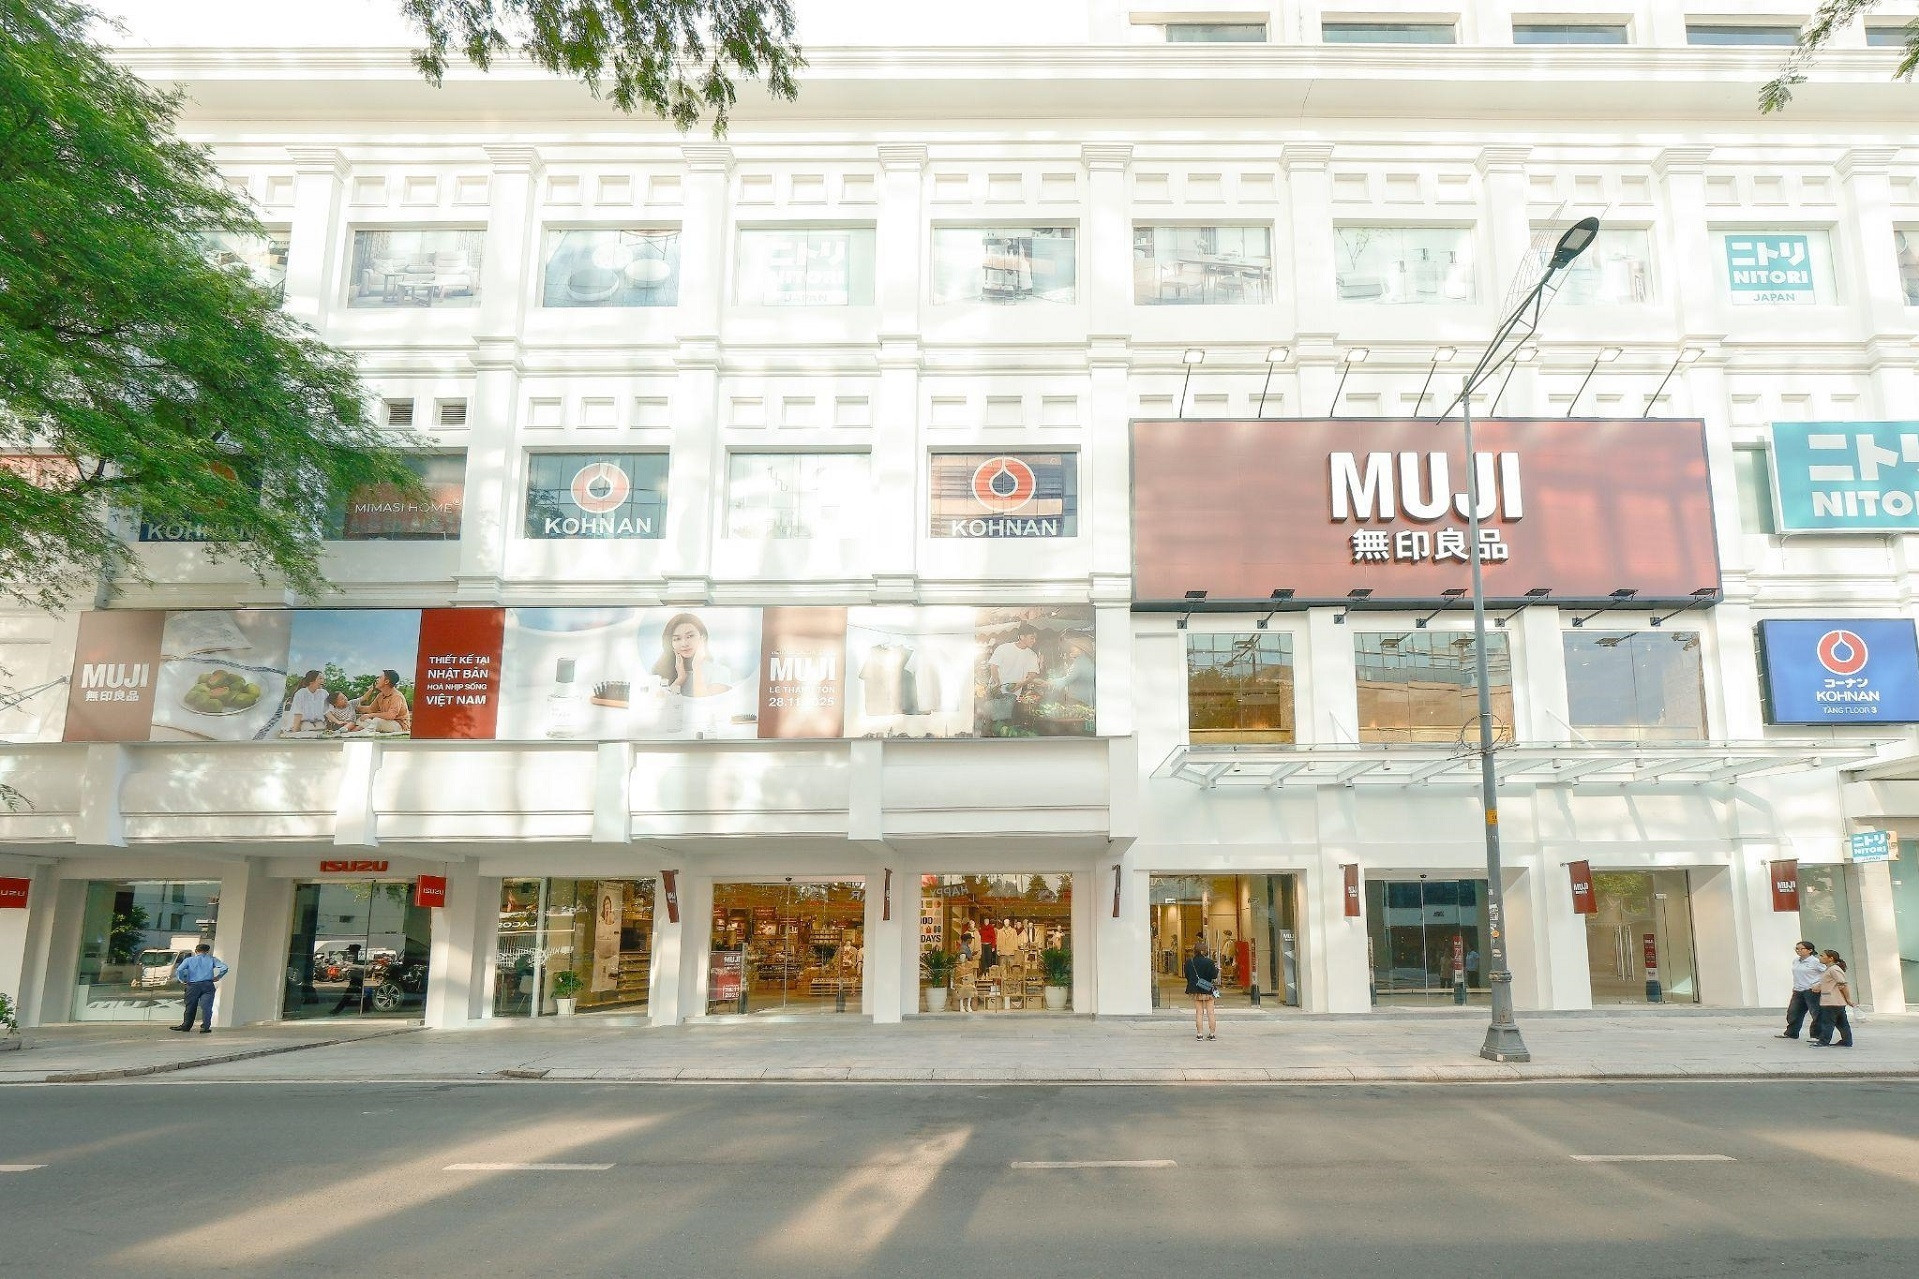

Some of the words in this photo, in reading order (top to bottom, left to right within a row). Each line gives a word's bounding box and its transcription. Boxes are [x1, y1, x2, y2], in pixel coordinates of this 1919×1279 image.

[1731, 242, 1805, 266] ニトリ
[1733, 270, 1809, 284] NITORI
[1753, 293, 1796, 302] JAPAN
[1329, 452, 1523, 524] MUJI
[354, 502, 404, 513] MIMASI
[408, 502, 452, 513] HOME
[1811, 490, 1919, 517] NITO
[544, 517, 652, 535] KOHNAN
[951, 519, 1057, 537] KOHNAN
[1350, 528, 1509, 564] 無印良品
[429, 654, 458, 664] THIẾT
[459, 654, 474, 664] KẾ
[475, 656, 490, 666] TẠI
[81, 663, 150, 688] MUJI
[428, 667, 461, 681] NHẬT
[770, 657, 836, 682] MUJI
[1824, 678, 1869, 688] コーナン
[85, 690, 139, 702] 無印良品
[426, 693, 454, 707] VIỆT
[456, 694, 487, 705] NAM
[1816, 691, 1880, 702] KOHNAN
[1845, 706, 1870, 714] FLOOR
[1871, 706, 1878, 714] 3
[1853, 833, 1885, 847] ニトリ
[1854, 846, 1887, 855] NITORI
[320, 860, 389, 873] ISUZU
[423, 888, 445, 896] ISUZU
[1777, 881, 1796, 889] MUJI
